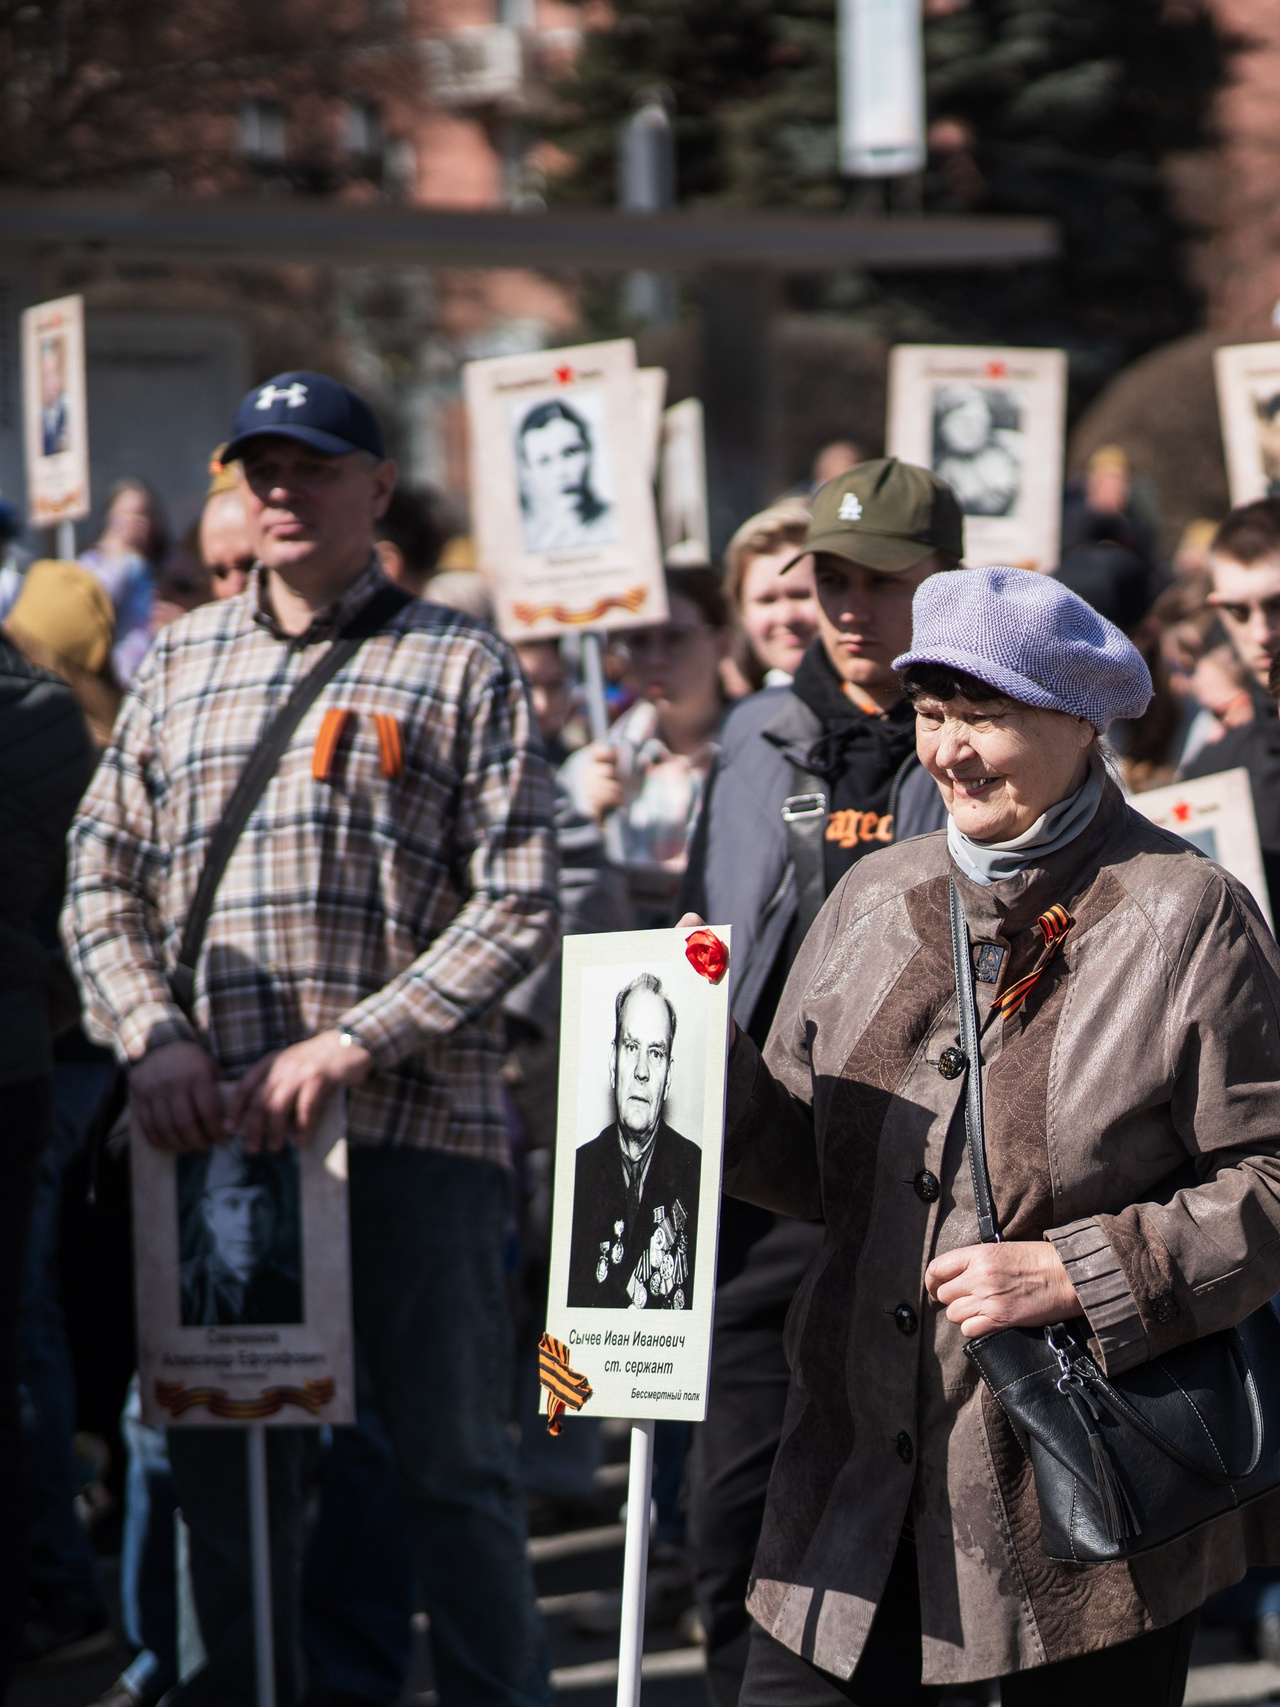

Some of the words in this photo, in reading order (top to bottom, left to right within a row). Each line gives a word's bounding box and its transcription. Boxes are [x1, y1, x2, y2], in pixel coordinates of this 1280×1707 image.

[569, 1329, 601, 1345] Сычев
[604, 1330, 630, 1346] Иван
[632, 1331, 686, 1347] Иванович
[604, 1360, 621, 1372] ст.
[625, 1361, 674, 1377] сержант
[630, 1388, 682, 1402] Бессмертный
[683, 1392, 701, 1402] полк
